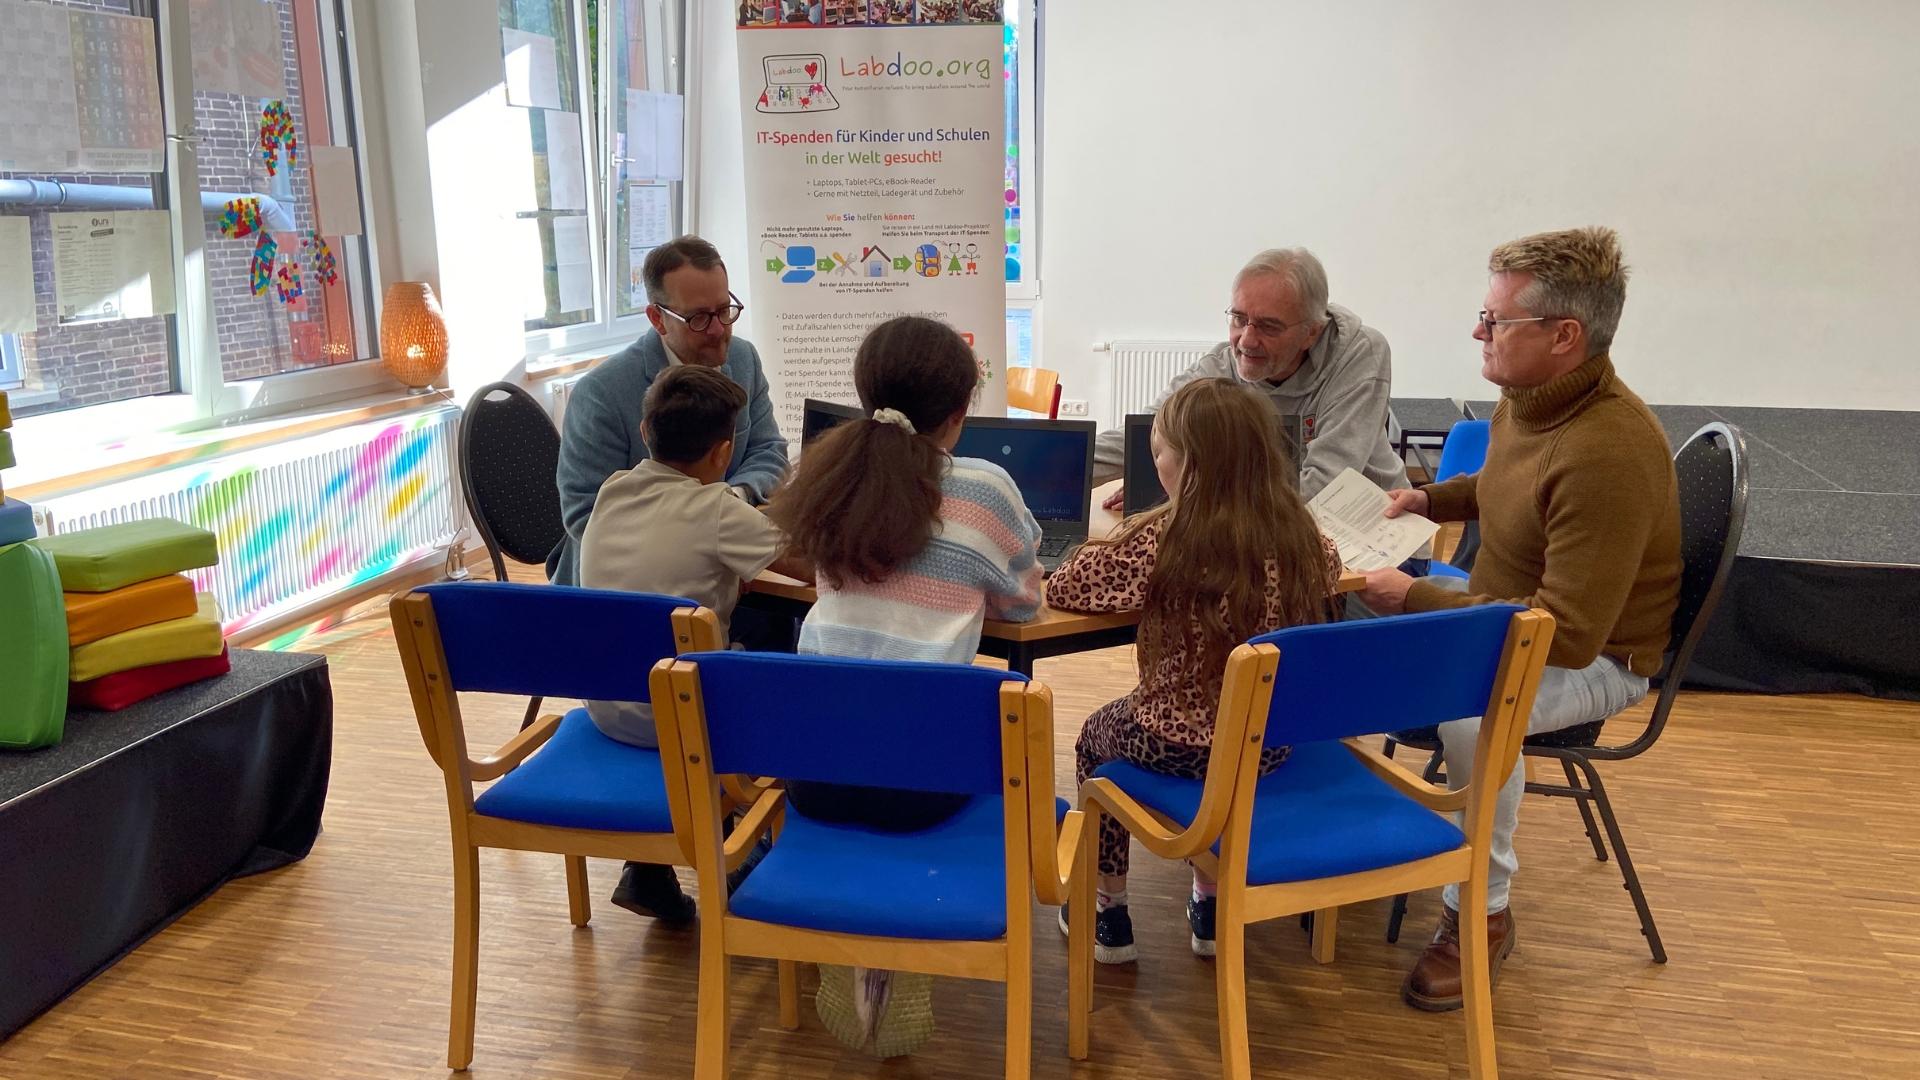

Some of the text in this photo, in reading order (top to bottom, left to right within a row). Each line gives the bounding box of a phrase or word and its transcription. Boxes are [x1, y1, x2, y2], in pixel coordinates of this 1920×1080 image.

[841, 51, 990, 80] Labdoo.org
[757, 127, 991, 147] IT-Spenden für Kinder und Schulen
[805, 149, 942, 167] in der Welt gesucht!
[813, 176, 936, 188] Laptops, Tablet-PCs, eBook-Reader
[813, 186, 965, 199] Gerne mit Netzteil, Ladegerät und Zubehör
[826, 211, 916, 222] Wie Sie helfen können:
[782, 312, 804, 320] Daten
[804, 312, 832, 320] werden
[832, 312, 853, 320] durch
[854, 311, 895, 320] mehrfaches
[796, 323, 842, 331] Zufallszahlen
[842, 322, 863, 331] sicher
[783, 335, 830, 345] Kindgerechte
[824, 346, 832, 354] in
[783, 357, 812, 365] werden
[784, 369, 797, 377] Der
[799, 369, 827, 378] Spender
[829, 368, 847, 377] kann
[807, 380, 842, 388] IT-Spende
[810, 390, 823, 398] des
[824, 389, 858, 399] Spenders
